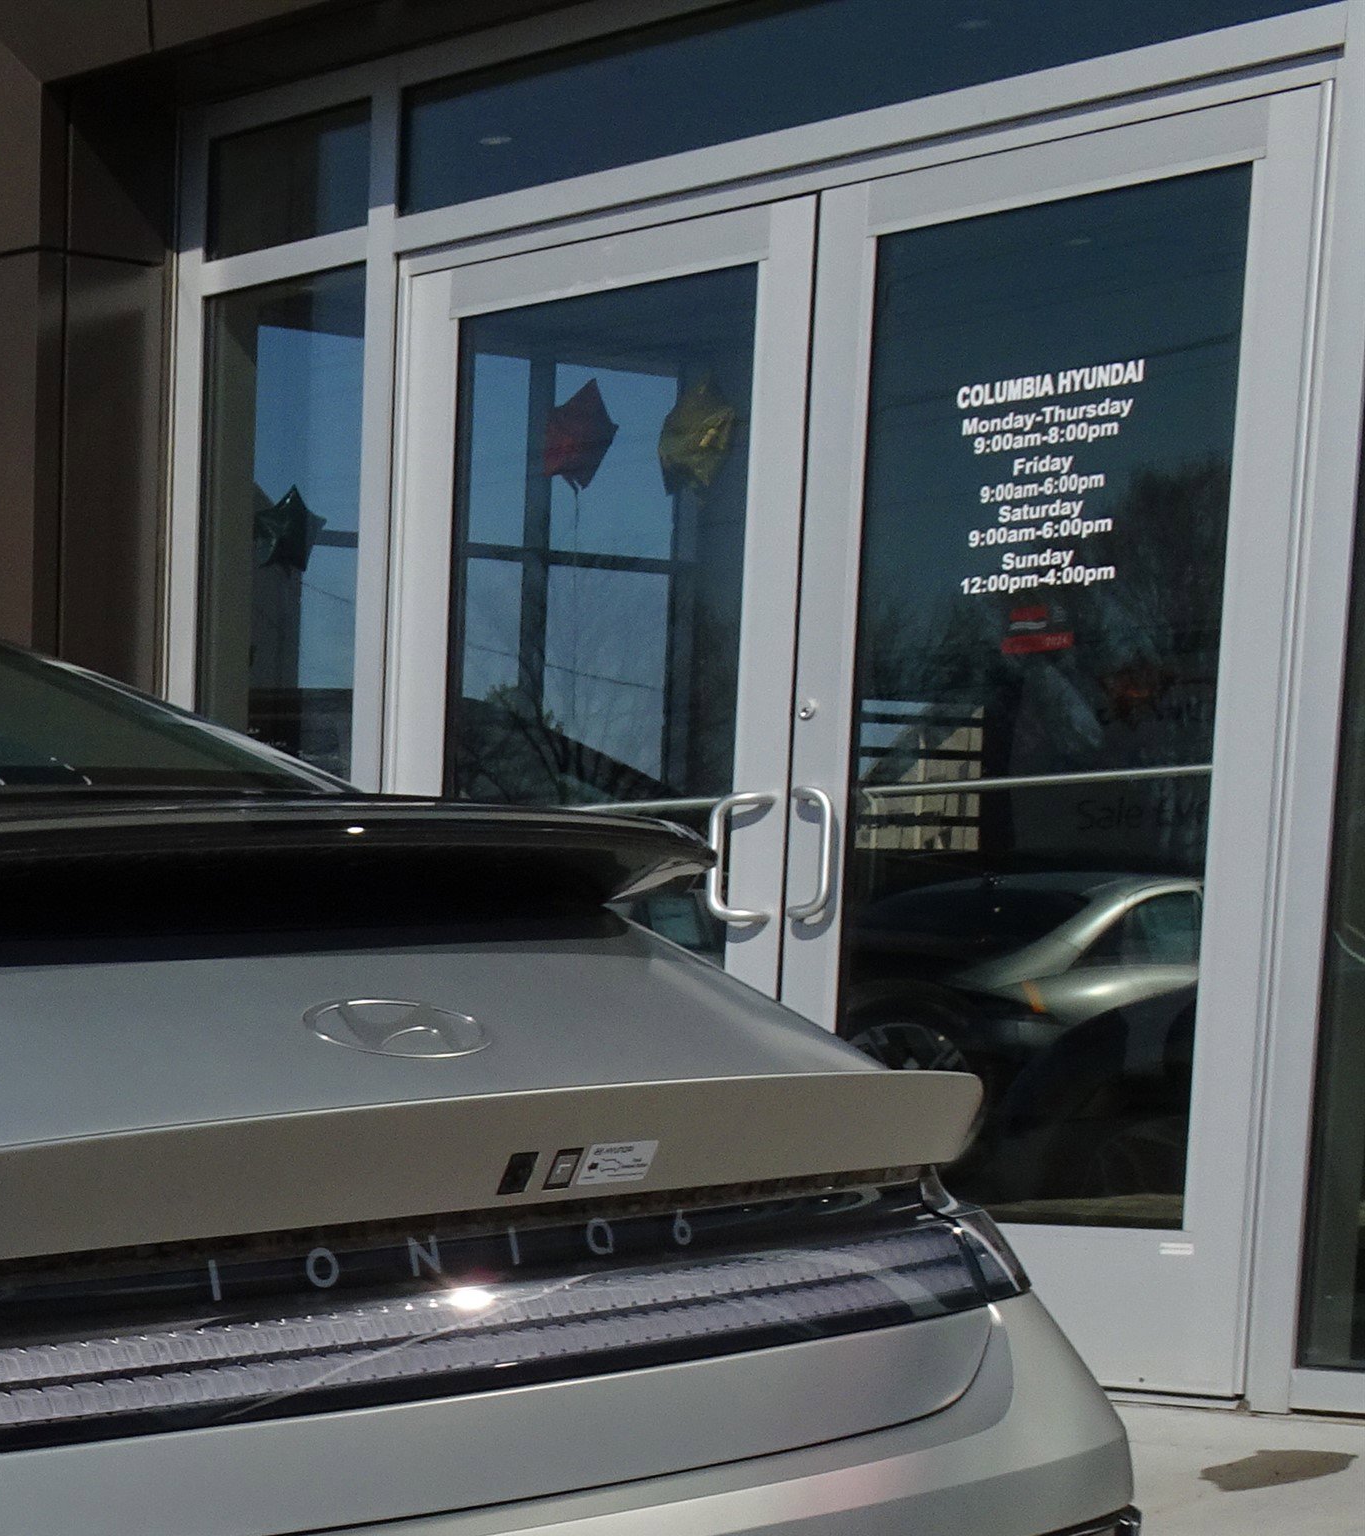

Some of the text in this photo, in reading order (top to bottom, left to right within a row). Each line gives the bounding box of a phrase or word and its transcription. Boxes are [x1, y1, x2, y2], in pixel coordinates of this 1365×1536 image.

[956, 359, 1145, 408] COLUMBIA HYUNDAI
[961, 397, 1133, 436] Monday-Thursday
[973, 420, 1119, 454] 9:00am-8:00pm
[1012, 455, 1073, 476] Friday
[980, 472, 1105, 503] 9:00am-6:00pm
[998, 500, 1083, 524] Saturday
[968, 517, 1113, 548] 9:00am-6:00pm
[1001, 549, 1074, 570] Sunday
[960, 564, 1116, 595] 12:00pm-4:00pm
[1077, 797, 1142, 831] Sale
